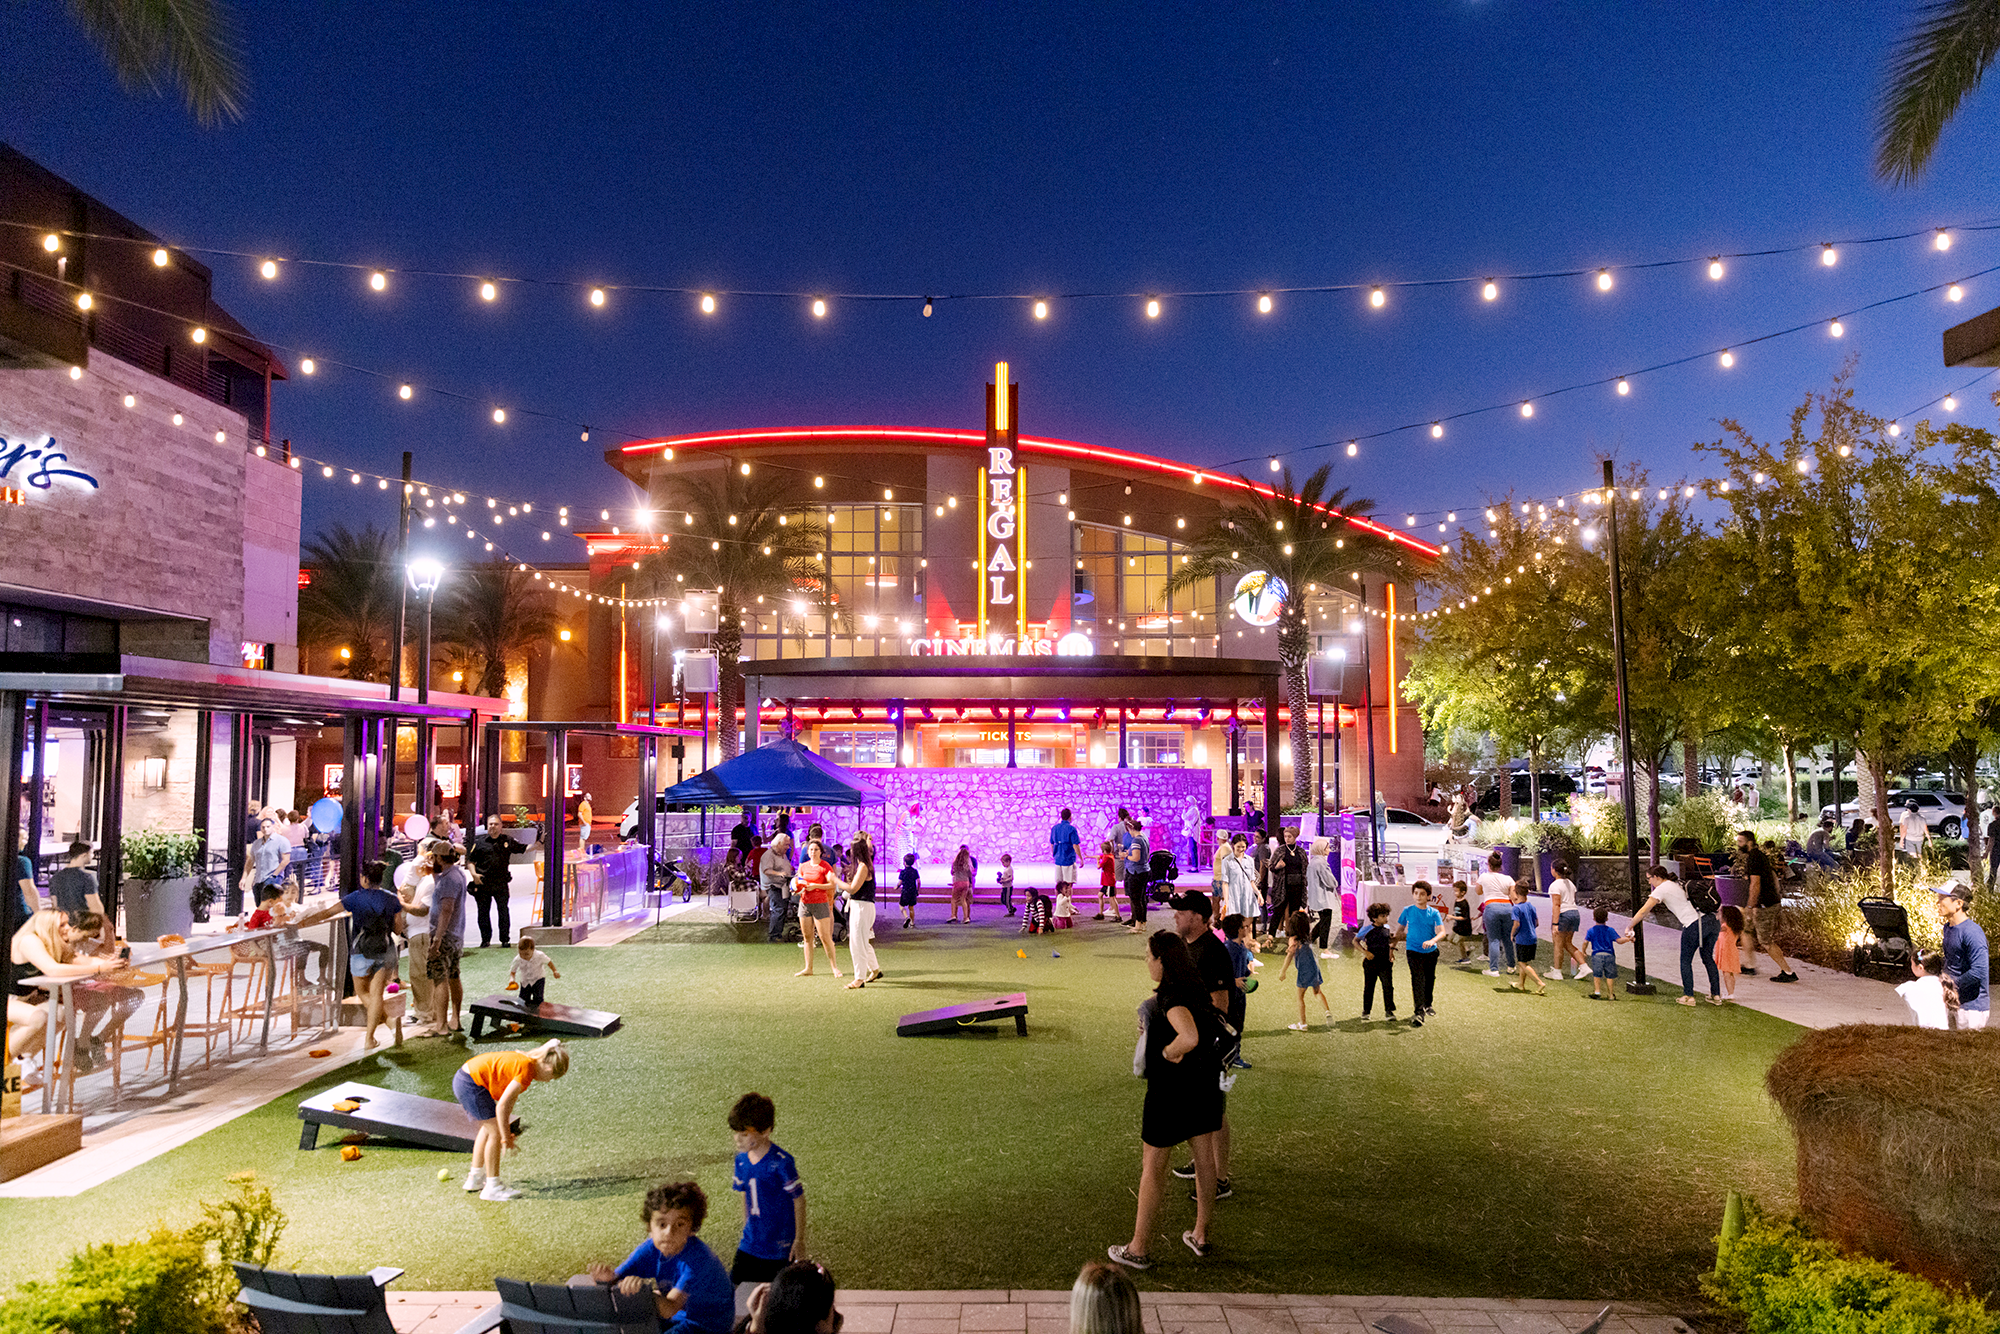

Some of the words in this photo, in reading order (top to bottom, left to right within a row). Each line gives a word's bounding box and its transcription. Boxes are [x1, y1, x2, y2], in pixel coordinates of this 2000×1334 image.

[988, 447, 1016, 604] REGAL
[910, 639, 1053, 657] CINEMAS
[979, 731, 1032, 741] TICKTS
[748, 1177, 760, 1215] 1
